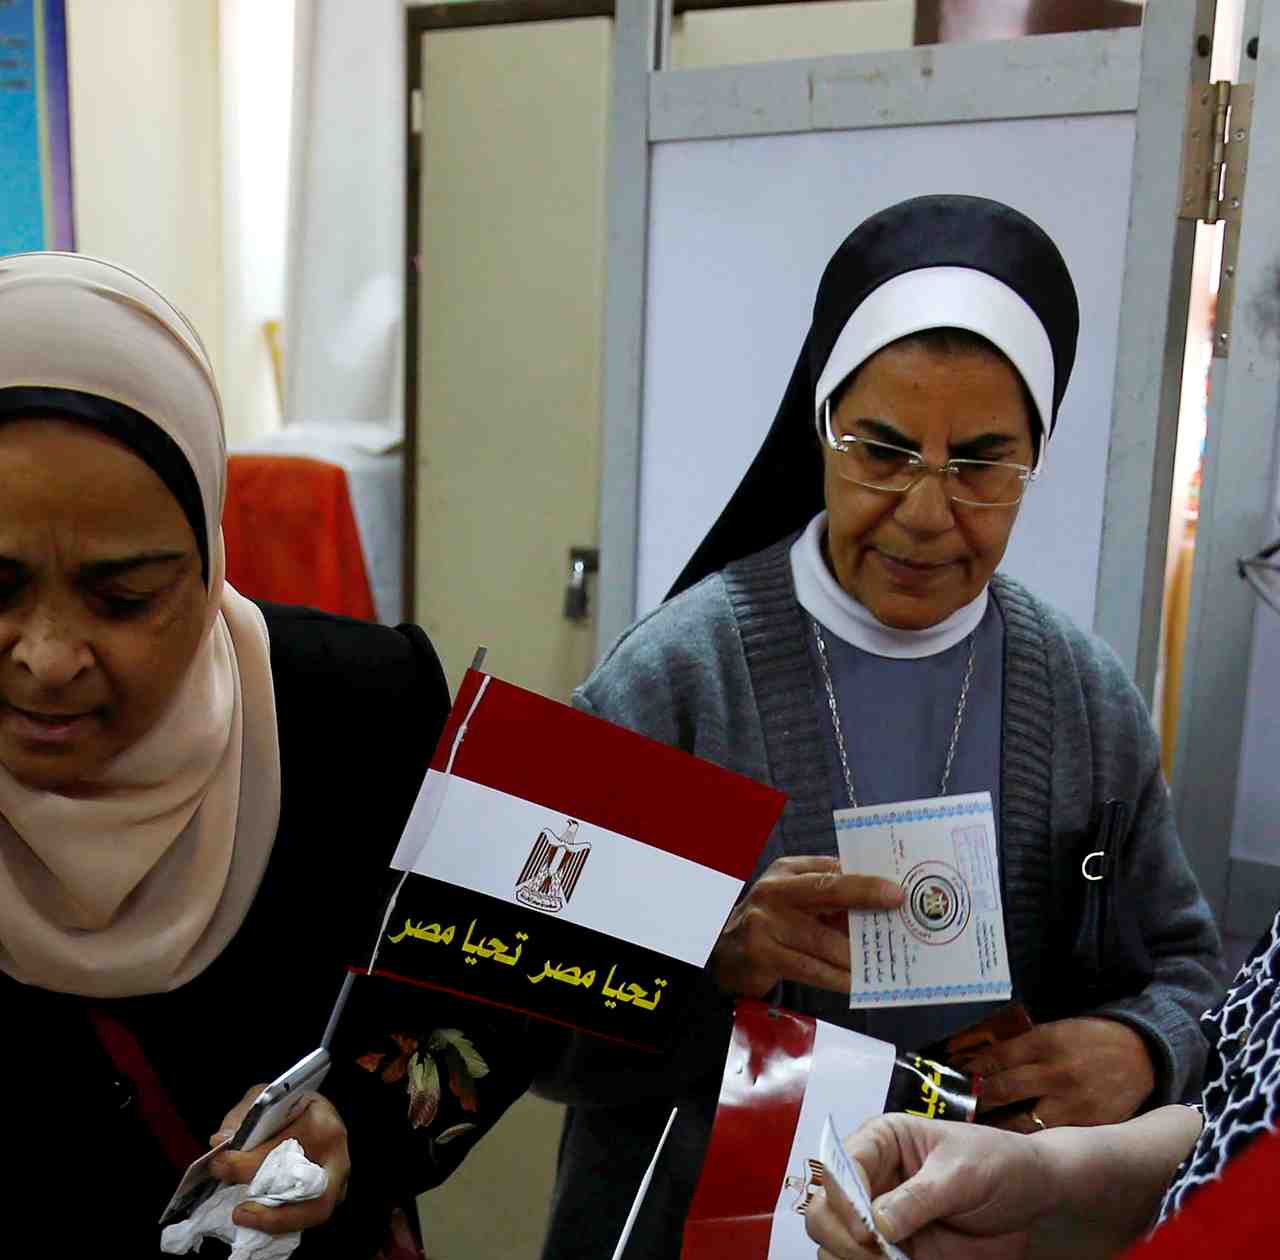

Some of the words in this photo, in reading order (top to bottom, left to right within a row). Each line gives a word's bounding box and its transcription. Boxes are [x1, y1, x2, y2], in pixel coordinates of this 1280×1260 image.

[387, 917, 455, 944] مصر
[461, 919, 529, 966] تحيا
[527, 959, 597, 989] مصر
[601, 964, 668, 1011] تحيا
